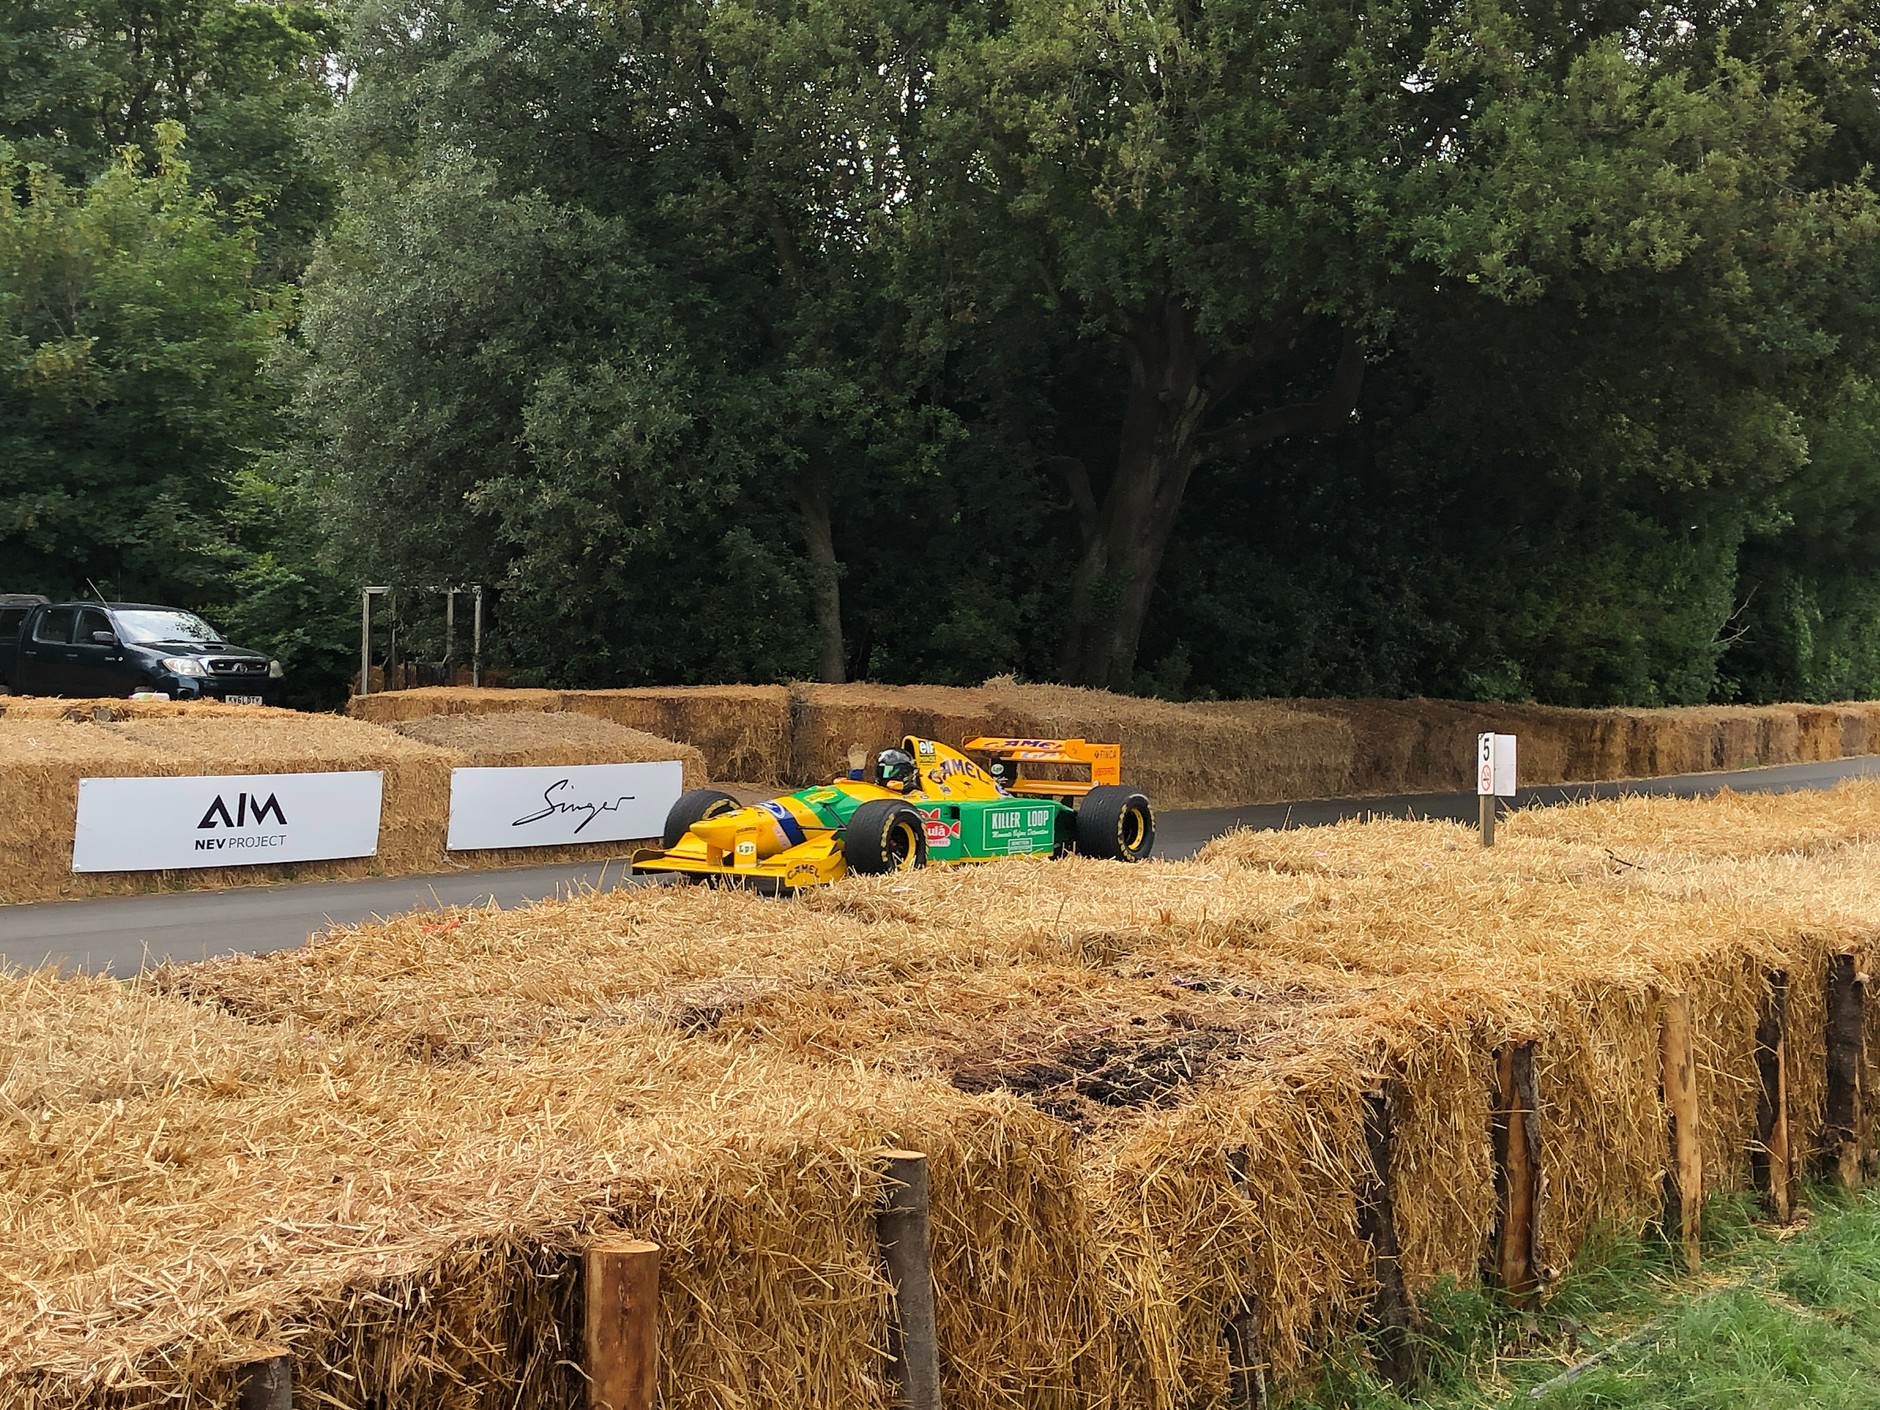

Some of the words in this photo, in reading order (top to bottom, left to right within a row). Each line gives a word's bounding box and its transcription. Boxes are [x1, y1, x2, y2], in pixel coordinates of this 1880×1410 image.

[919, 740, 934, 754] elf
[1483, 737, 1490, 761] 5
[928, 759, 990, 785] CAMEL
[197, 792, 288, 829] AIM
[511, 779, 635, 834] Singer
[992, 811, 1021, 829] KILLER
[1027, 810, 1049, 827] LOOP
[194, 838, 226, 851] NEV
[228, 835, 287, 848] PROJECT
[787, 864, 820, 880] CAMEL
